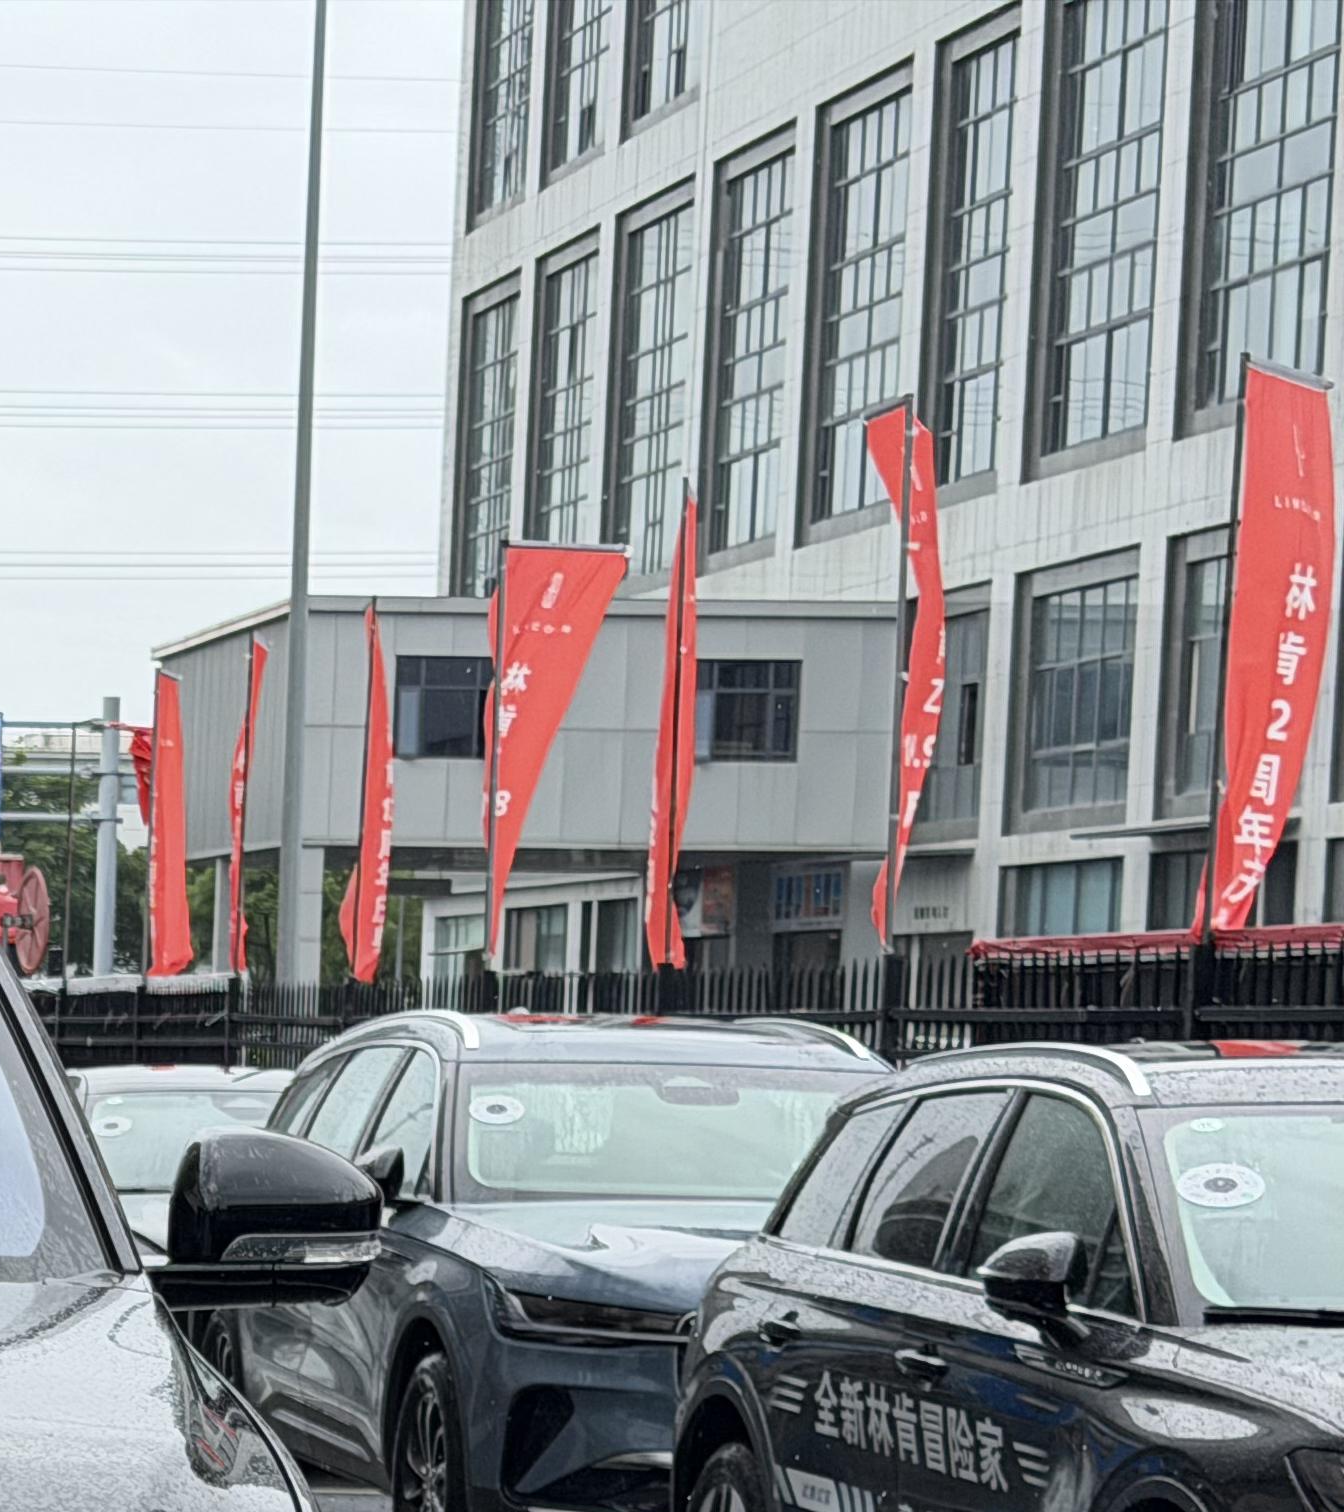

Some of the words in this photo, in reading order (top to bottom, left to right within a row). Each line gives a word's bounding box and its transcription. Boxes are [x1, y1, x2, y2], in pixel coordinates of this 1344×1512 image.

[813, 1369, 1010, 1493] 全新林肯冒险家
